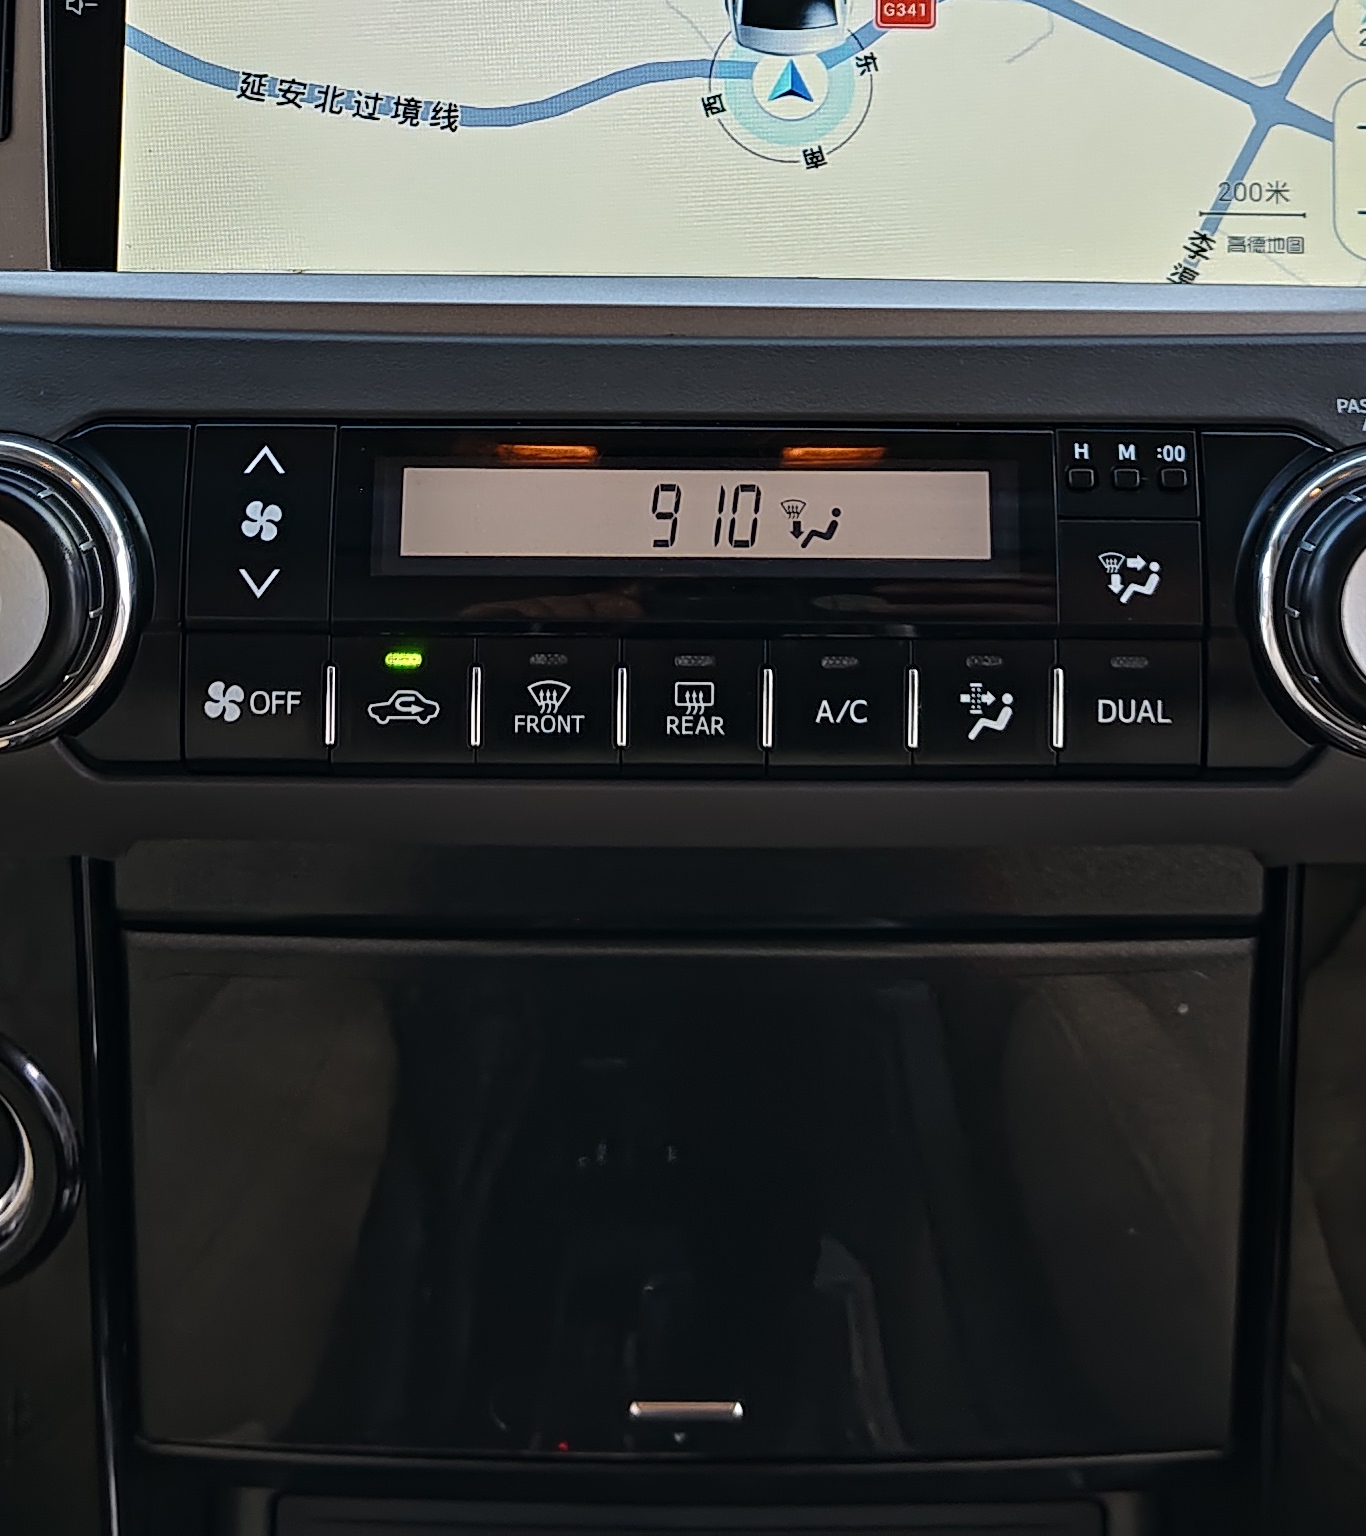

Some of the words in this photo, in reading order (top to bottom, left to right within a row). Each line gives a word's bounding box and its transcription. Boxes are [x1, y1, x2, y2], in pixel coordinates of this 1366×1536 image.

[883, 2, 926, 17] G341
[237, 71, 460, 132] 延安北过境线
[702, 94, 727, 117] 西
[1218, 181, 1291, 204] 200米
[1227, 236, 1305, 254] 高德地图
[1073, 442, 1090, 460] H
[1117, 443, 1136, 461] M
[1156, 444, 1186, 462] :00
[249, 691, 302, 715] OFF
[815, 699, 868, 724] A/C
[1097, 698, 1173, 724] DUAL
[514, 713, 586, 735] FRONT
[666, 714, 725, 736] REAR
